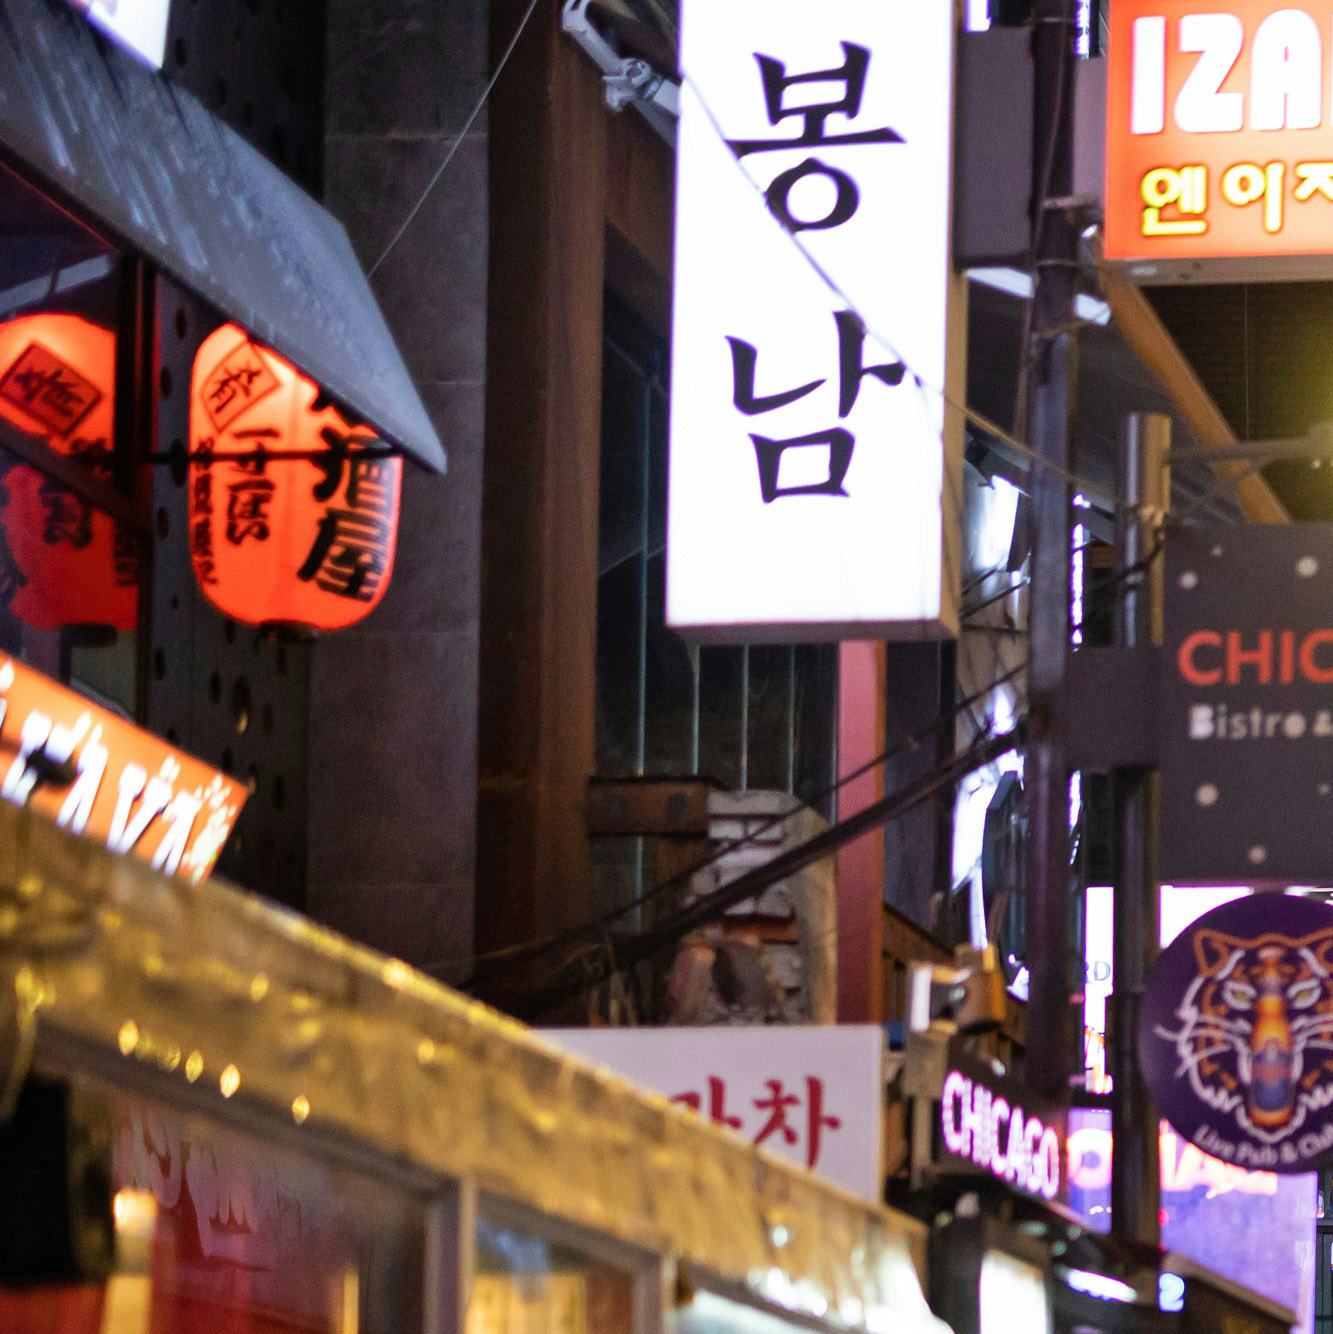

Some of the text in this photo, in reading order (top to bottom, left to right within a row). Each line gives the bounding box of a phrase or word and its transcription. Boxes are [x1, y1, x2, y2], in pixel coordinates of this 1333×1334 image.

[723, 40, 908, 504] 봉남
[1189, 703, 1307, 740] Bistro
[943, 1071, 1060, 1199] CHICAGO
